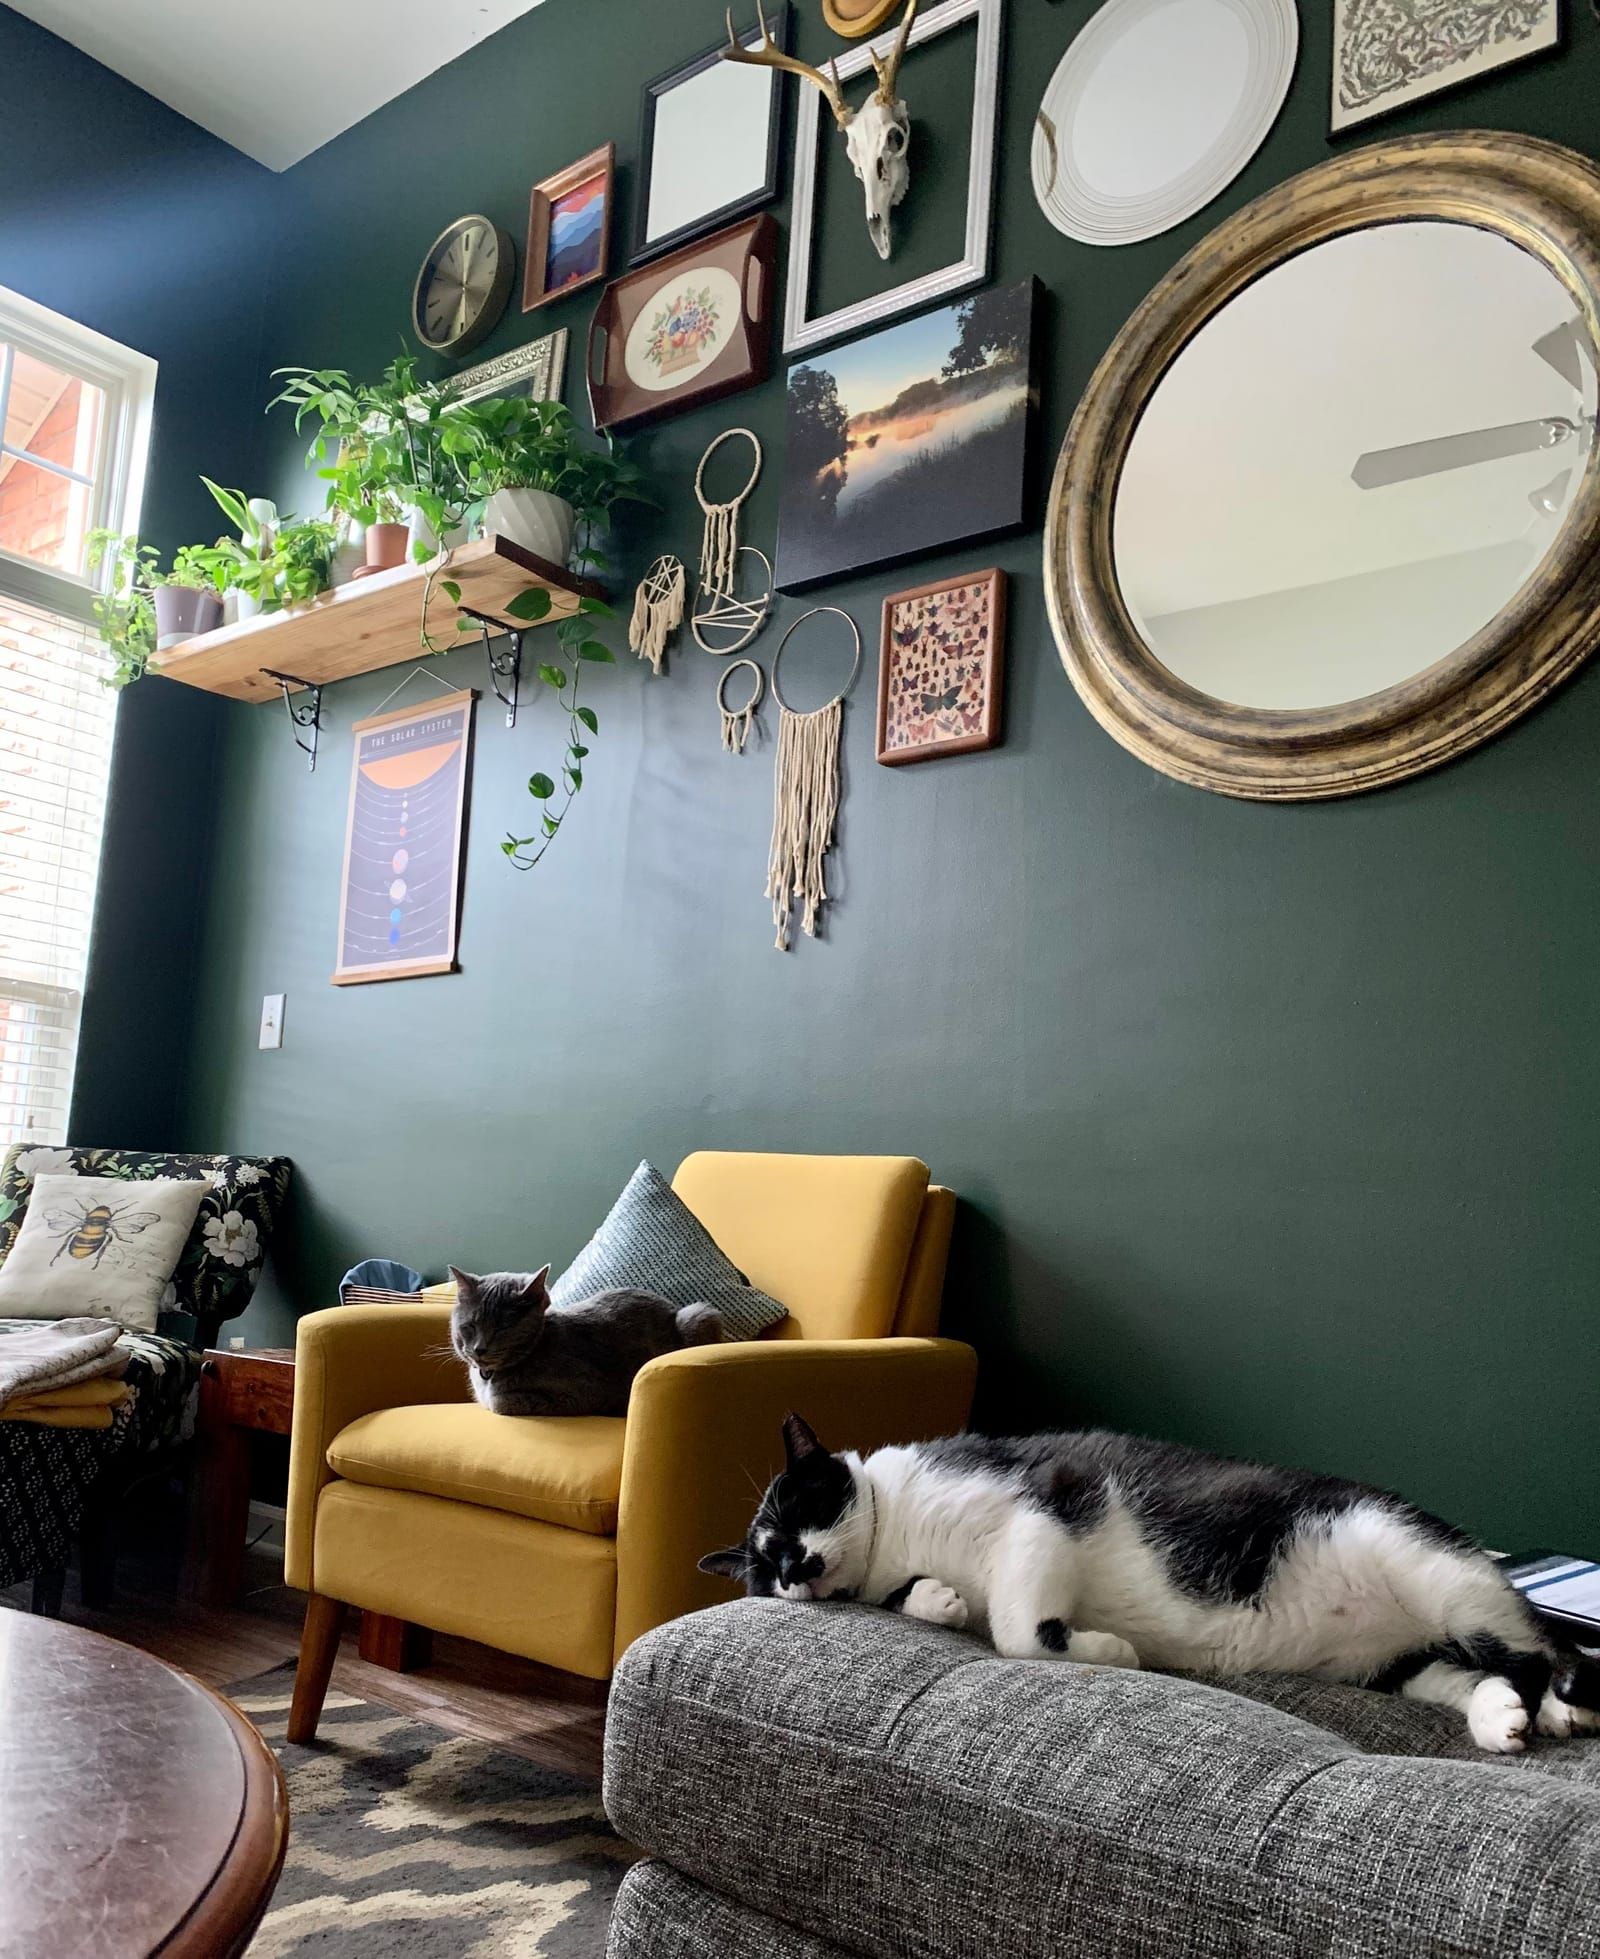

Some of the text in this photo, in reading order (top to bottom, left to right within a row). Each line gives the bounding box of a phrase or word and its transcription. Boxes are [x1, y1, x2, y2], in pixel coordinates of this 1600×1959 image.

[372, 718, 452, 747] THE SOLAR SYSTEM
